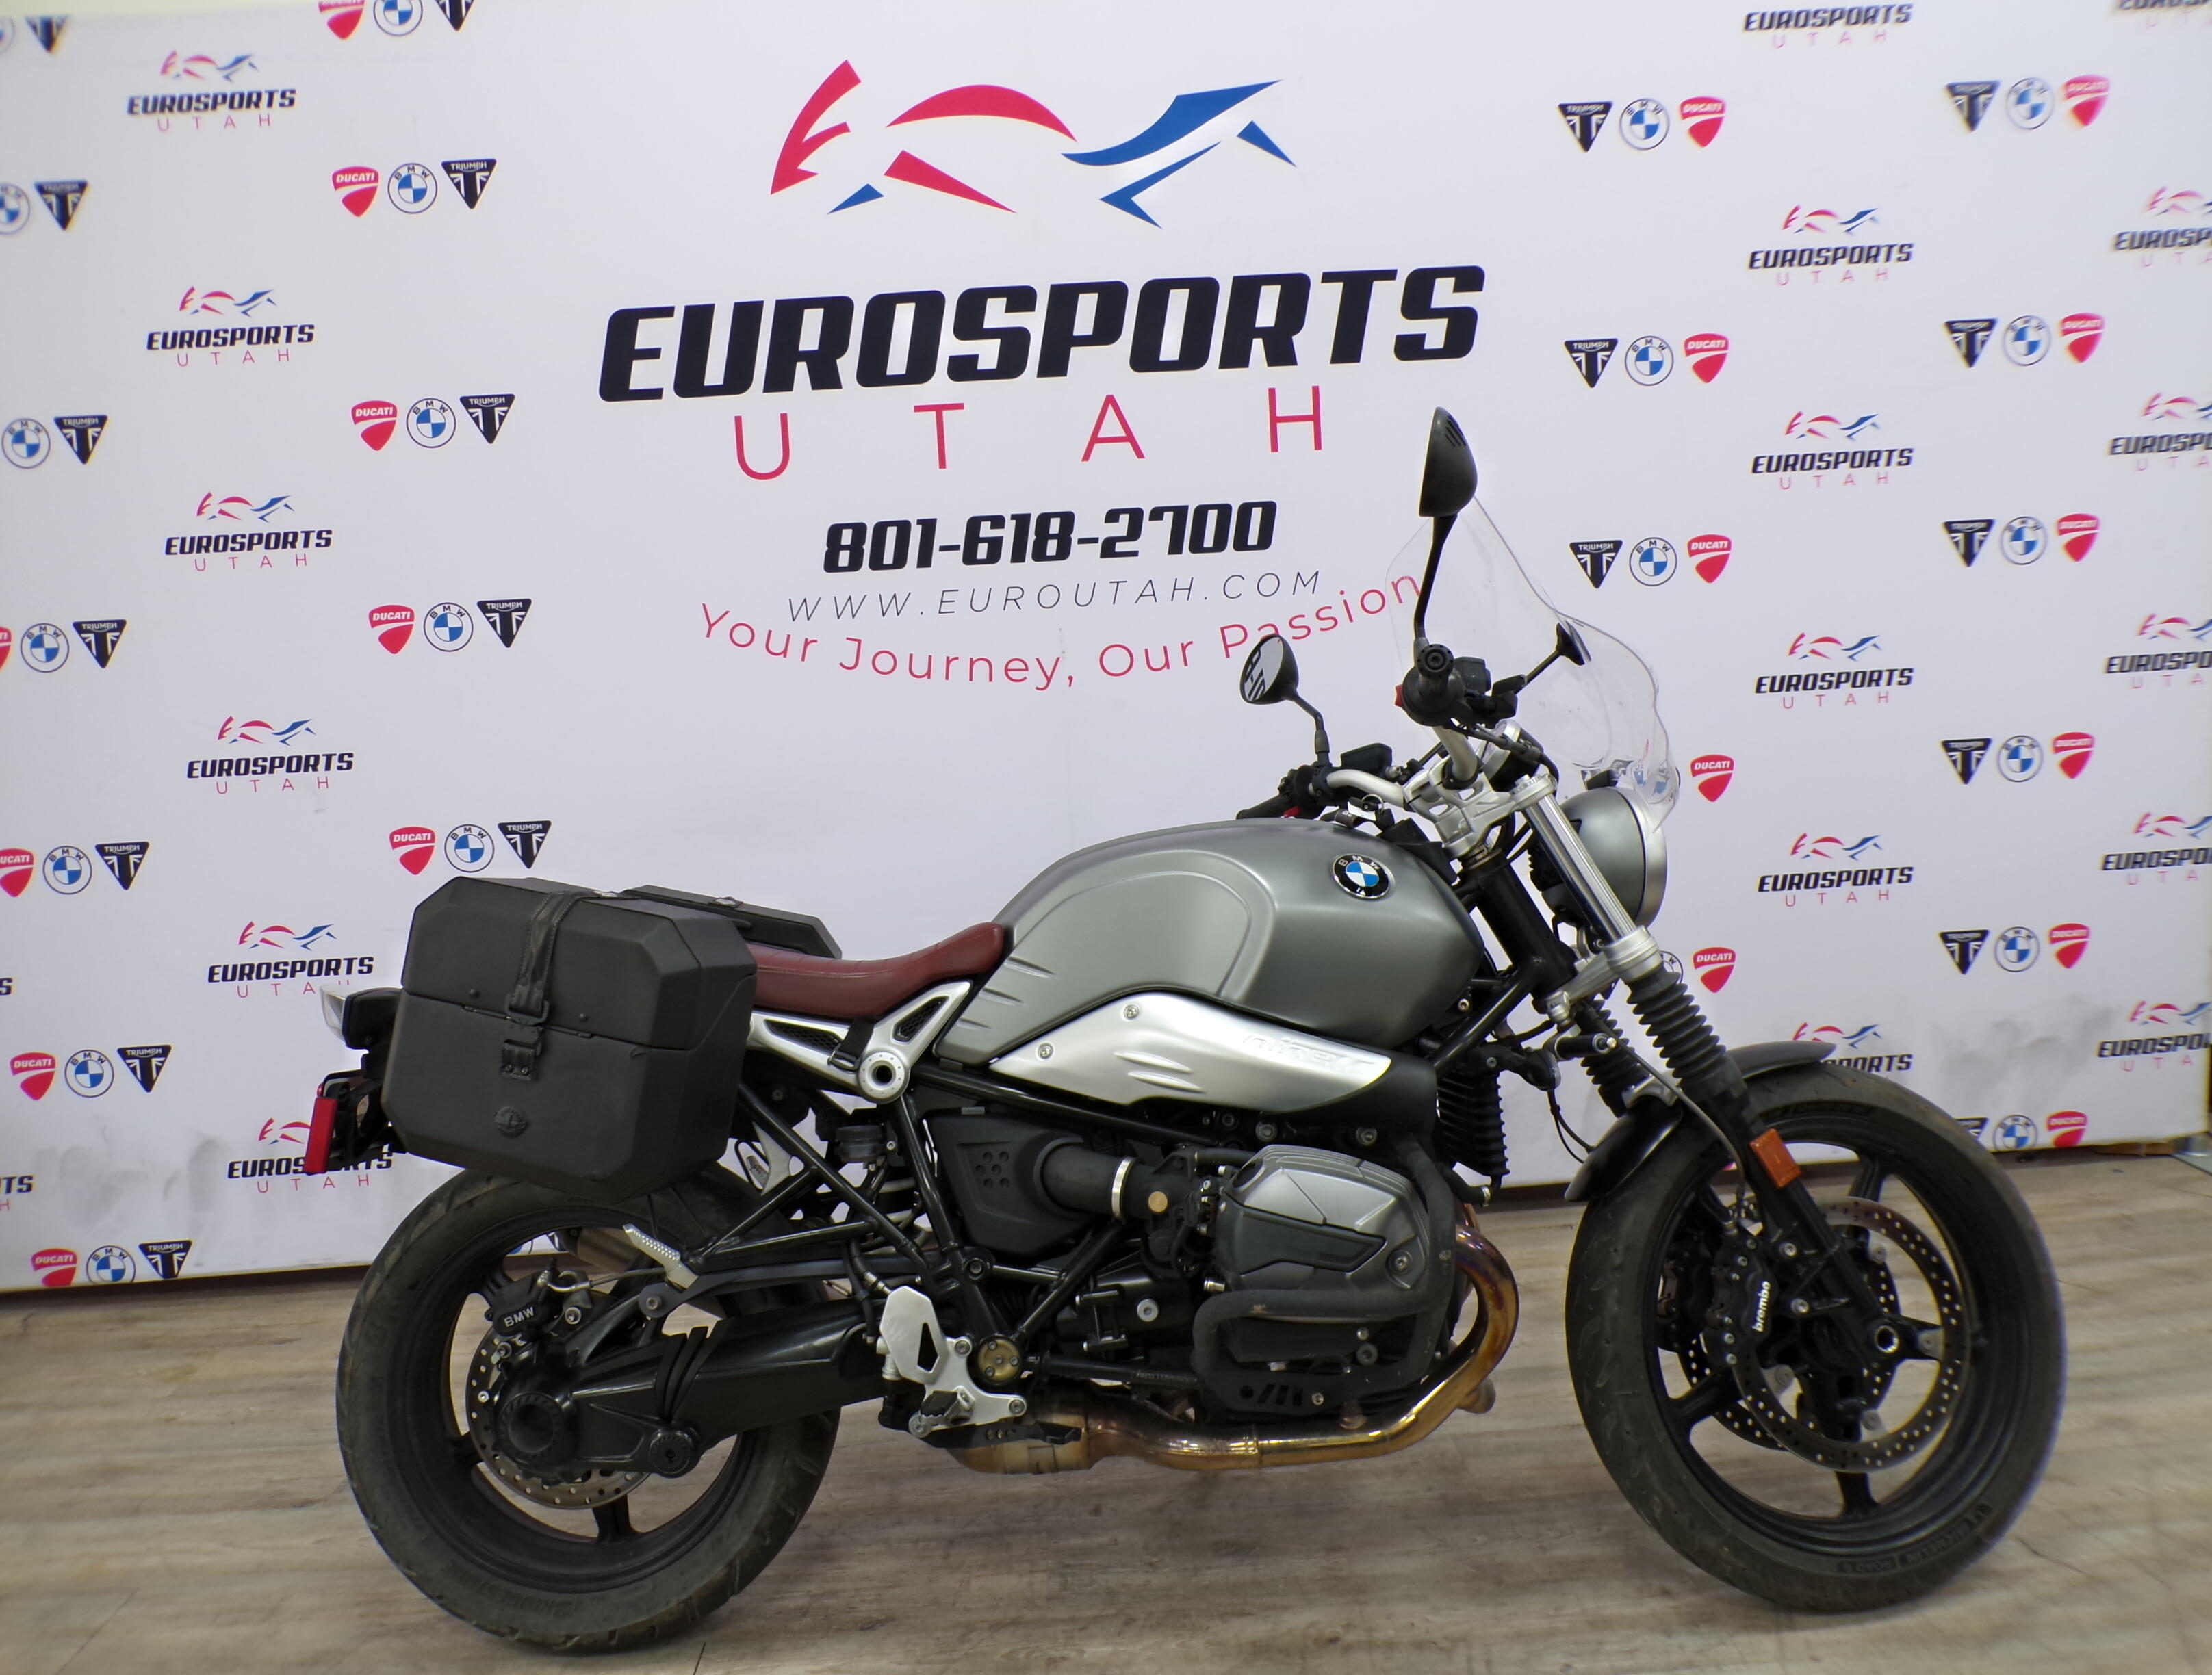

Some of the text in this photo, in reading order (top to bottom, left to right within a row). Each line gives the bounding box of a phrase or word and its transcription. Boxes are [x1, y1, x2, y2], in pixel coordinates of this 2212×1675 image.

[1745, 5, 1911, 31] EUROSPORTS
[1773, 29, 1888, 49] UTAH
[128, 90, 296, 115] EUROSPORTS
[157, 116, 272, 132] UTAH
[450, 161, 487, 170] TRIUMPH
[336, 172, 375, 182] DUCATI
[394, 166, 430, 180] BMW
[1749, 244, 1912, 269] EUROSPORTS
[1777, 268, 1890, 286] UTAH
[147, 324, 314, 350] EUROSPORTS
[599, 265, 1485, 402] EUROSPORTS
[1573, 341, 1609, 349] TRIUMPH
[1630, 338, 1667, 352] BMW
[1688, 339, 1725, 350] DUCATI
[177, 349, 290, 367] UTAH
[412, 400, 449, 415] BMW
[469, 396, 506, 405] TRIUMPH
[355, 406, 394, 417] DUCATI
[8, 421, 43, 435] BMW
[62, 418, 99, 426] TRIUMPH
[733, 385, 1323, 481] UTAH
[1752, 448, 1913, 473] EUROSPORTS
[1779, 471, 1891, 490] UTAH
[165, 530, 332, 555] EUROSPORTS
[823, 501, 1278, 573] 801-618-2700
[1578, 543, 1614, 551] TRIUMPH
[1635, 540, 1670, 554] BMW
[1692, 541, 1728, 550] DUCATI
[194, 555, 307, 571] UTAH
[788, 570, 1320, 622] WWW.EUROUTAH.COM
[429, 605, 466, 619] BMW
[485, 601, 522, 610] TRIUMPH
[373, 611, 411, 621] DUCATI
[26, 625, 62, 639] BMW
[81, 622, 118, 630] TRIUMPH
[701, 603, 821, 662] Your
[838, 637, 1076, 692] Journey,
[1097, 640, 1194, 677] Our
[1755, 668, 1914, 694] EUROSPORTS
[1782, 690, 1891, 710] UTAH
[187, 753, 354, 778] EUROSPORTS
[1695, 761, 1731, 770] DUCATI
[216, 777, 329, 794] UTAH
[450, 827, 487, 840] BMW
[506, 823, 543, 831] TRIUMPH
[394, 833, 432, 842] DUCATI
[49, 848, 85, 862] BMW
[103, 844, 140, 853] TRIUMPH
[1337, 855, 1380, 871] BMW
[2103, 848, 2212, 870] EUROSPO
[1758, 867, 1914, 892] EUROSPORTS
[1785, 889, 1891, 907] UTAH
[1697, 952, 1733, 962] DUCATI
[208, 957, 374, 983] EUROSPORTS
[70, 1052, 107, 1065] BMW
[125, 1047, 162, 1056] TRIUMPH
[14, 1059, 52, 1068] DUCATI
[257, 1173, 369, 1193] UTAH
[147, 1243, 183, 1251] TRIUMPH
[36, 1254, 73, 1264] DUCATI
[92, 1248, 128, 1261] BMW
[1751, 1281, 1771, 1332] brembo
[504, 1306, 535, 1327] BMW
